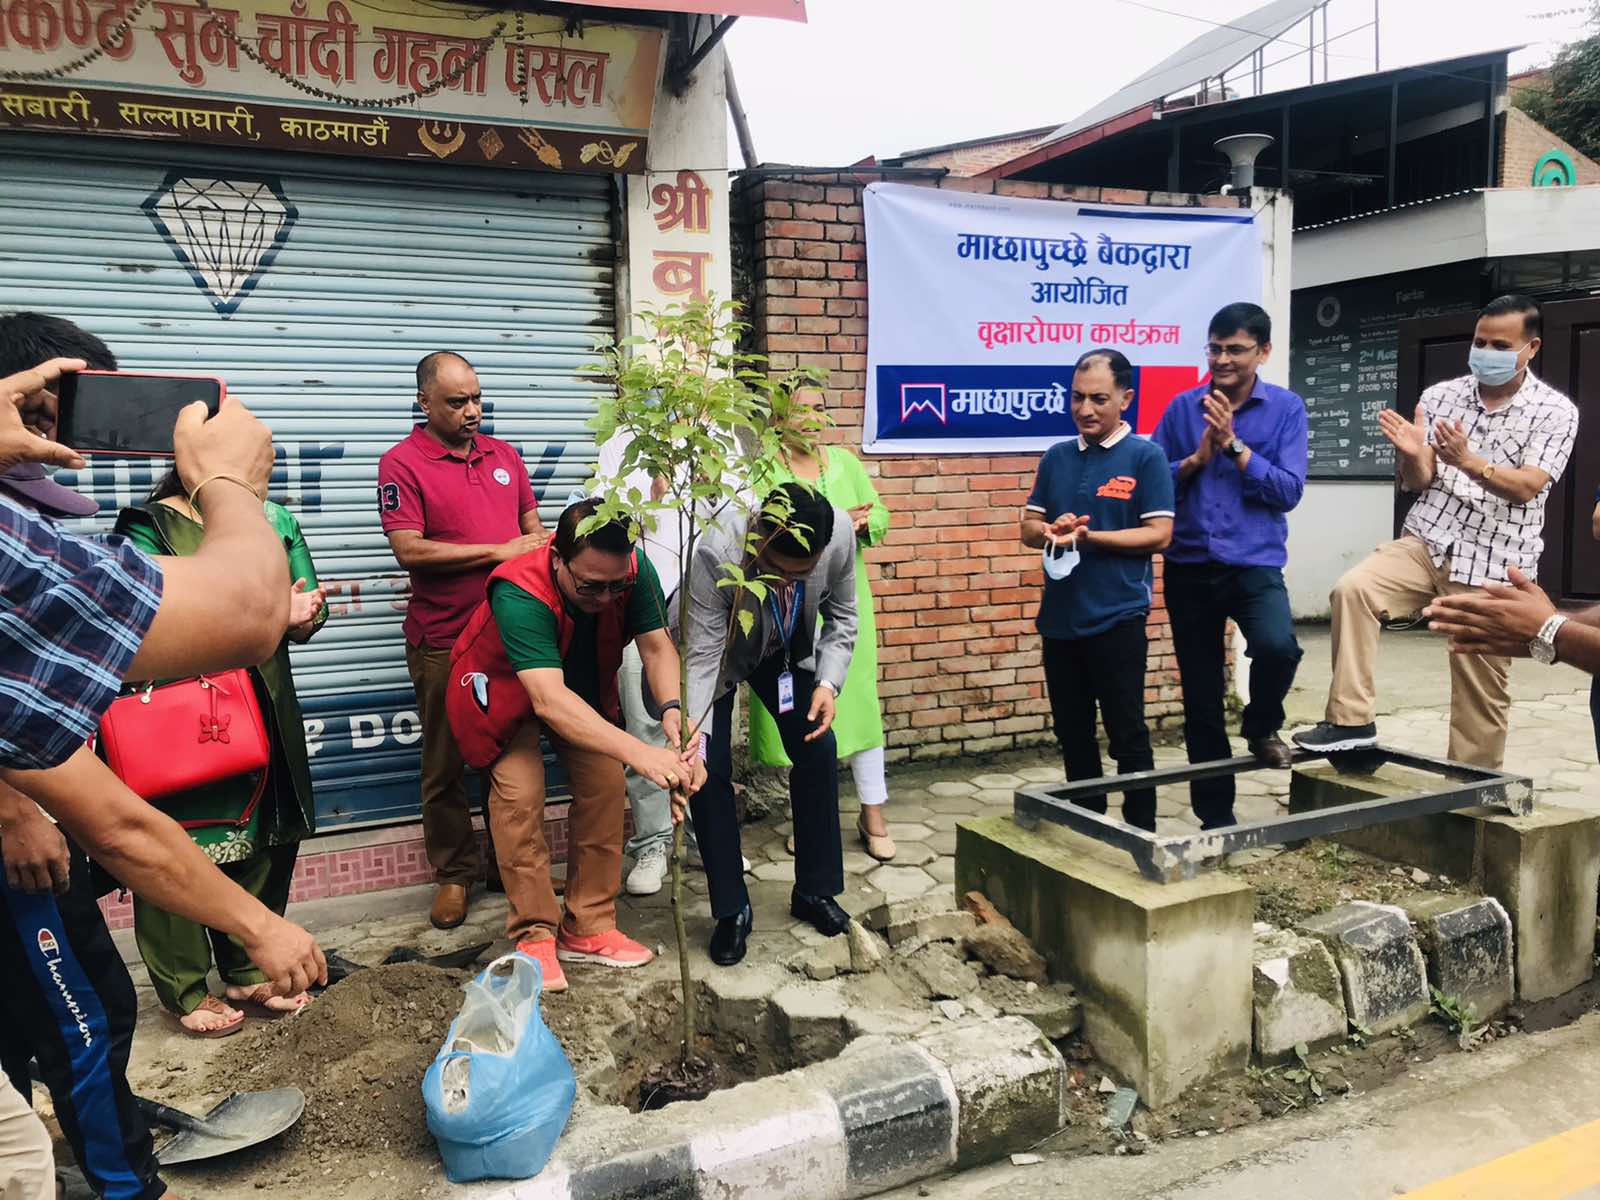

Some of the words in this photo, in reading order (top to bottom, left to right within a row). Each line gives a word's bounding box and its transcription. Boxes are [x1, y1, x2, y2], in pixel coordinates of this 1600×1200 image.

[153, 2, 241, 86] सुन
[373, 27, 490, 98] गहना
[504, 41, 611, 108] पसल
[118, 102, 261, 142] सल्लाघारी,
[652, 169, 712, 233] श्री
[957, 231, 1088, 271] माछापुच्छ्रे
[1031, 276, 1128, 306] आयोजित
[977, 315, 1083, 349] वृक्षारोपण
[1090, 318, 1181, 346] कार्यक्रम
[350, 710, 423, 749] DO
